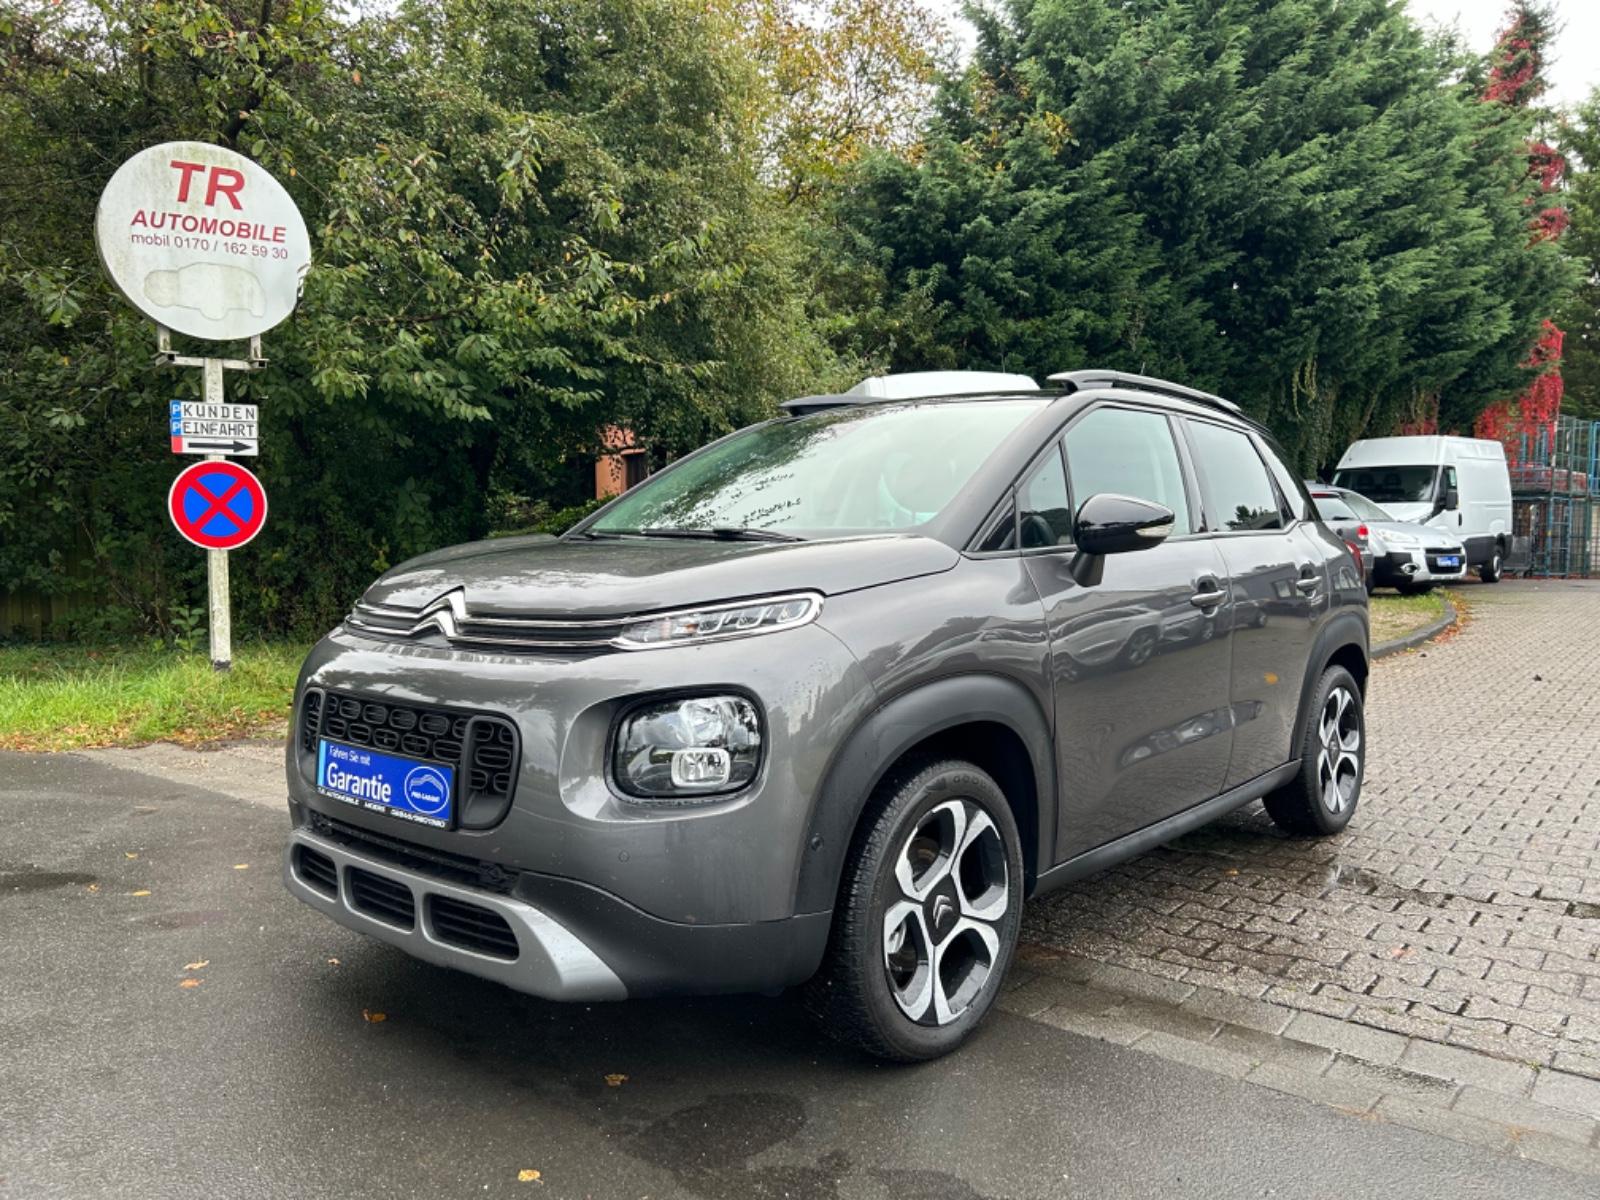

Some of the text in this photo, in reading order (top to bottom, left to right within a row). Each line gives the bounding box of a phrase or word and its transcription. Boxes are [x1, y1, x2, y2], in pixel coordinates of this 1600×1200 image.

[170, 160, 246, 211] TR
[130, 209, 287, 243] AUTOMOBILE
[131, 233, 288, 259] mobil 0170 / 162 59 30
[183, 404, 255, 420] KUNDEN
[183, 421, 255, 437] EINFAHRT
[329, 745, 371, 766] Fahren Sie mit
[327, 762, 391, 803] Garantie
